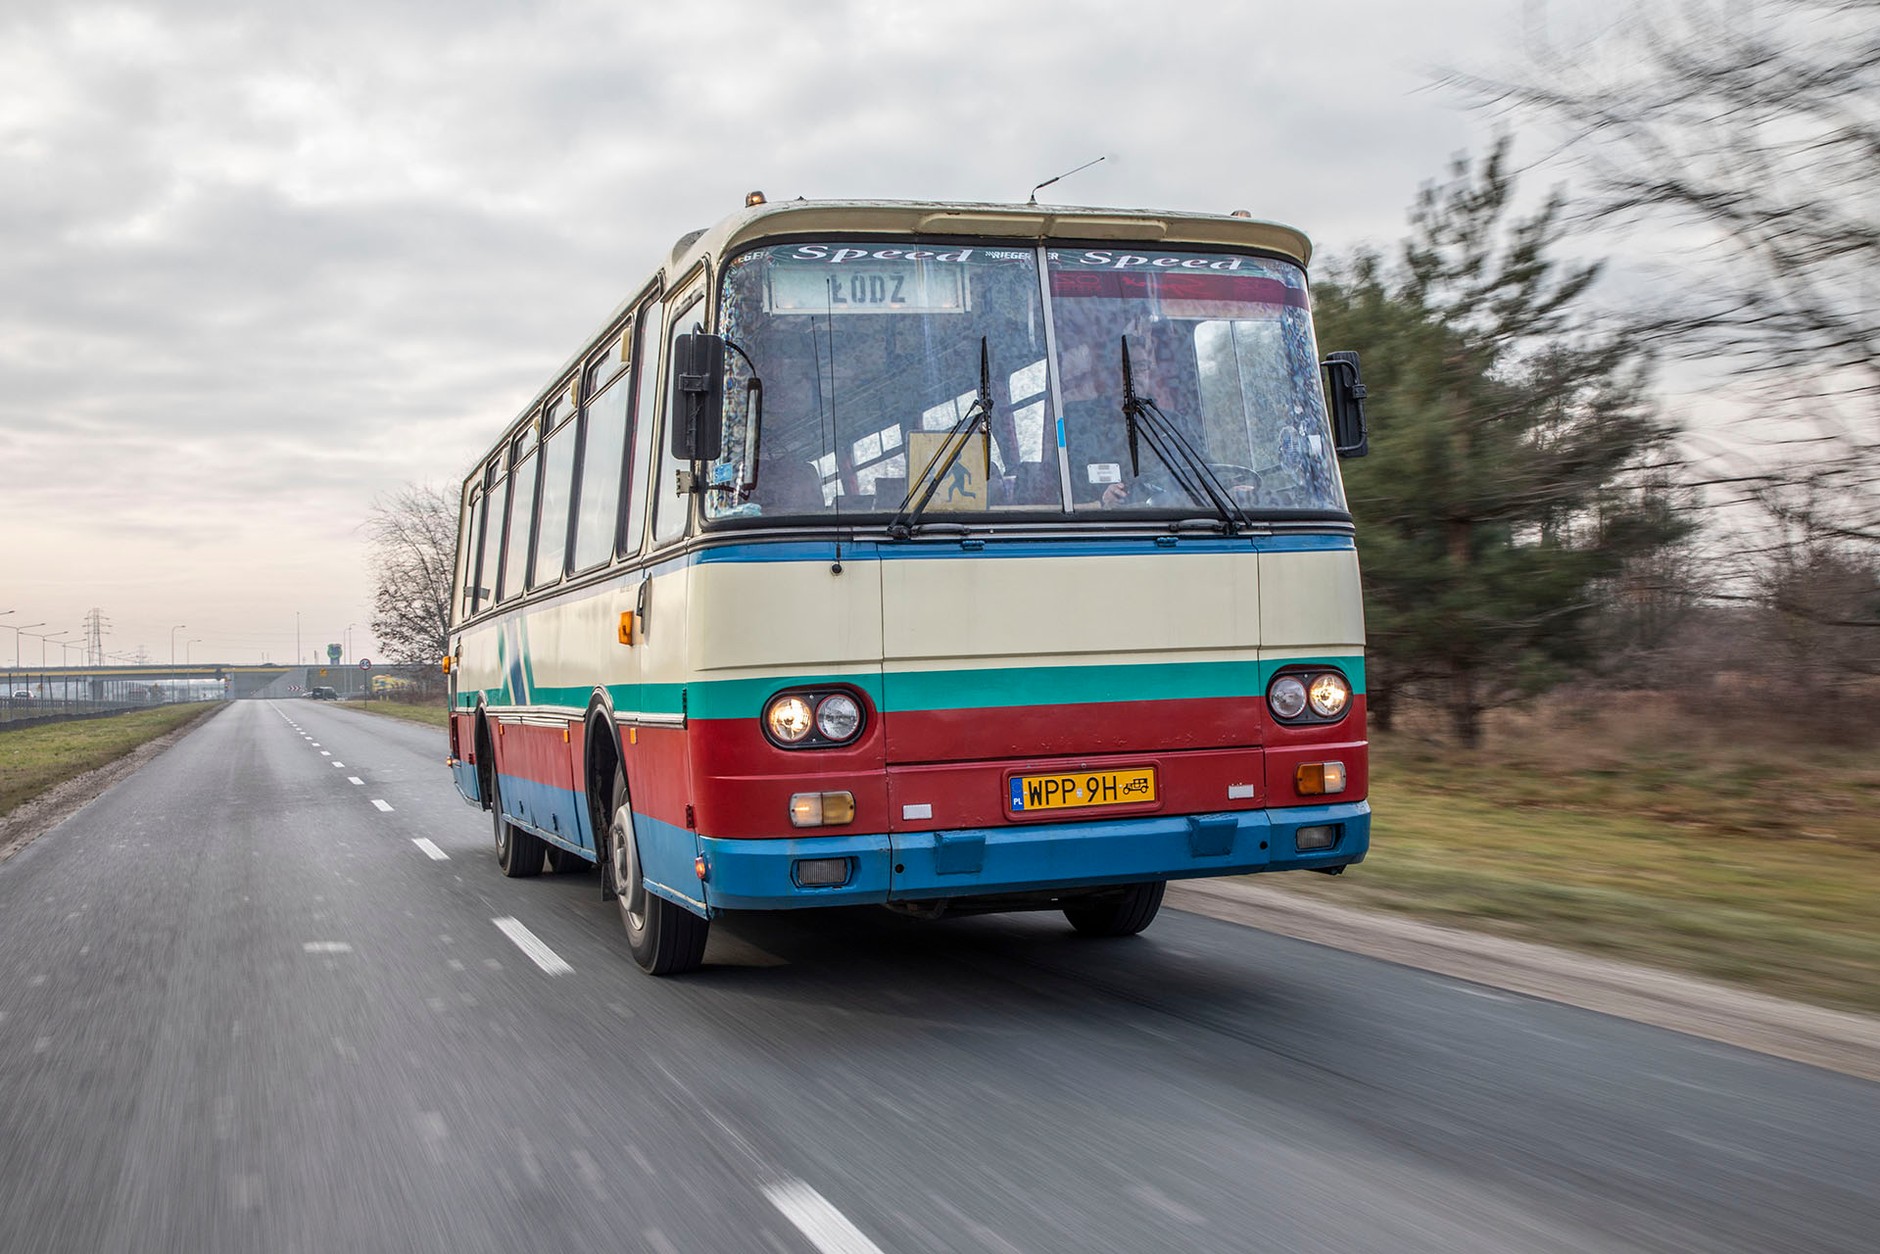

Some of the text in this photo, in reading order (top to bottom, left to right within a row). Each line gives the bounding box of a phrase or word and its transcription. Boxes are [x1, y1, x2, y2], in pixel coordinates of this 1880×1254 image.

[792, 245, 973, 263] Speed
[1079, 251, 1242, 270] Speed
[1028, 775, 1118, 806] WPP 9H
[1013, 797, 1023, 805] PL
